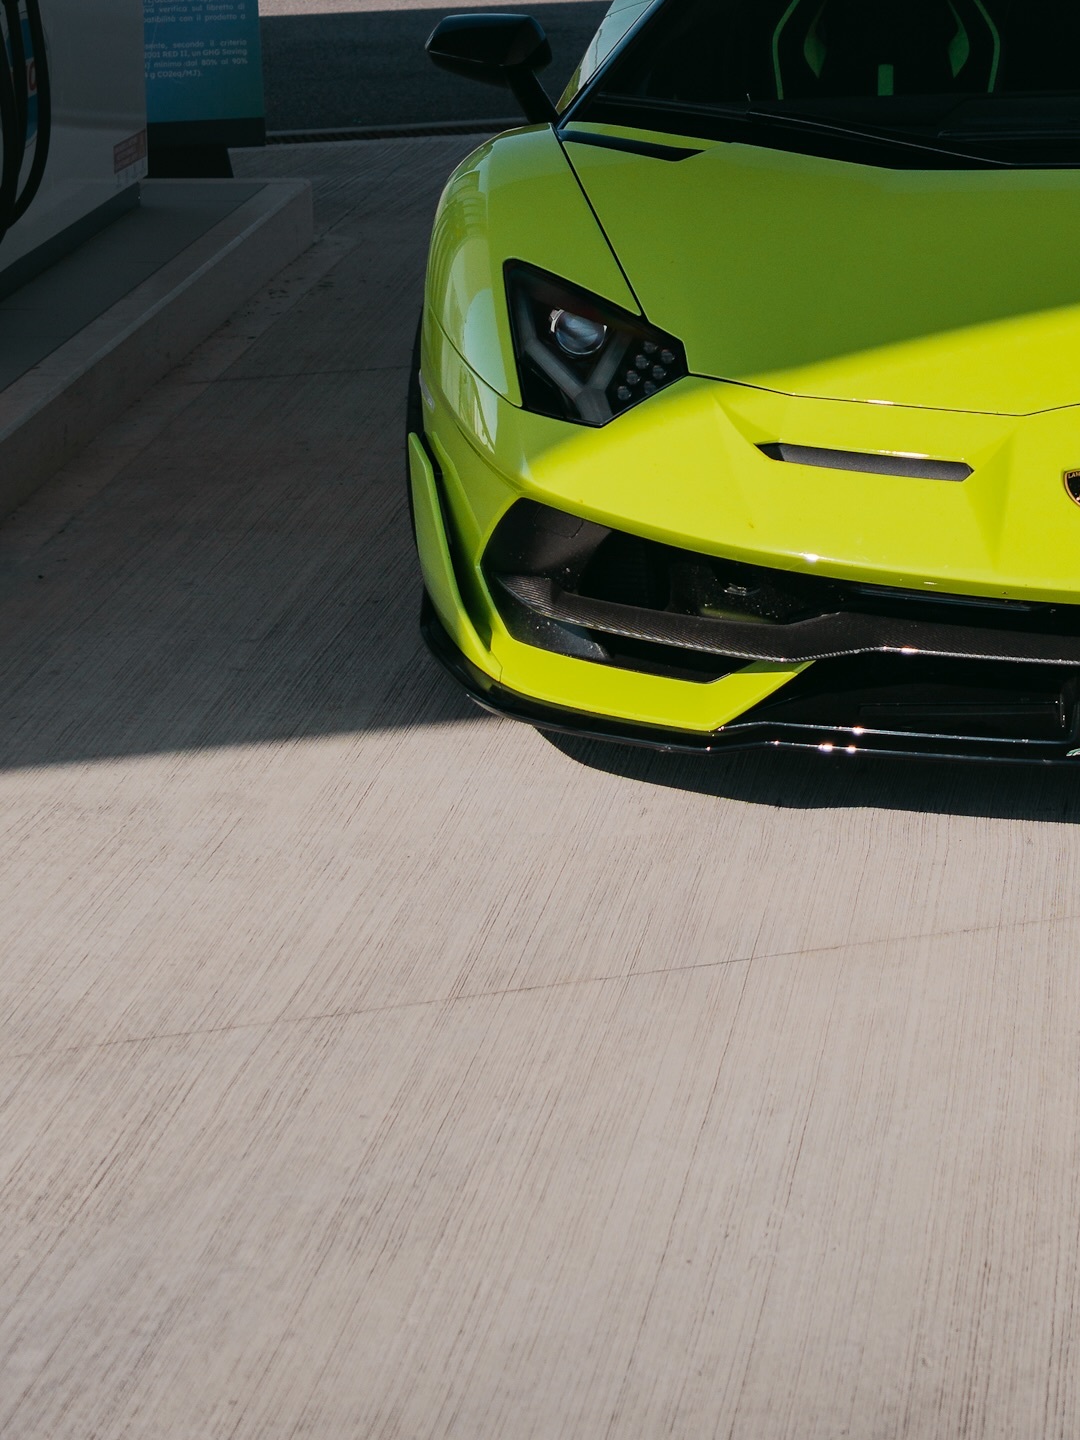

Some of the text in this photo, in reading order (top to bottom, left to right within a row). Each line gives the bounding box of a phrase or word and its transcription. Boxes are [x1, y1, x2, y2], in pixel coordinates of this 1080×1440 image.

[192, 4, 203, 12] sul
[205, 13, 238, 22] prodotto
[221, 48, 248, 57] Saving
[201, 58, 217, 66] 80%
[231, 57, 248, 65] 90%
